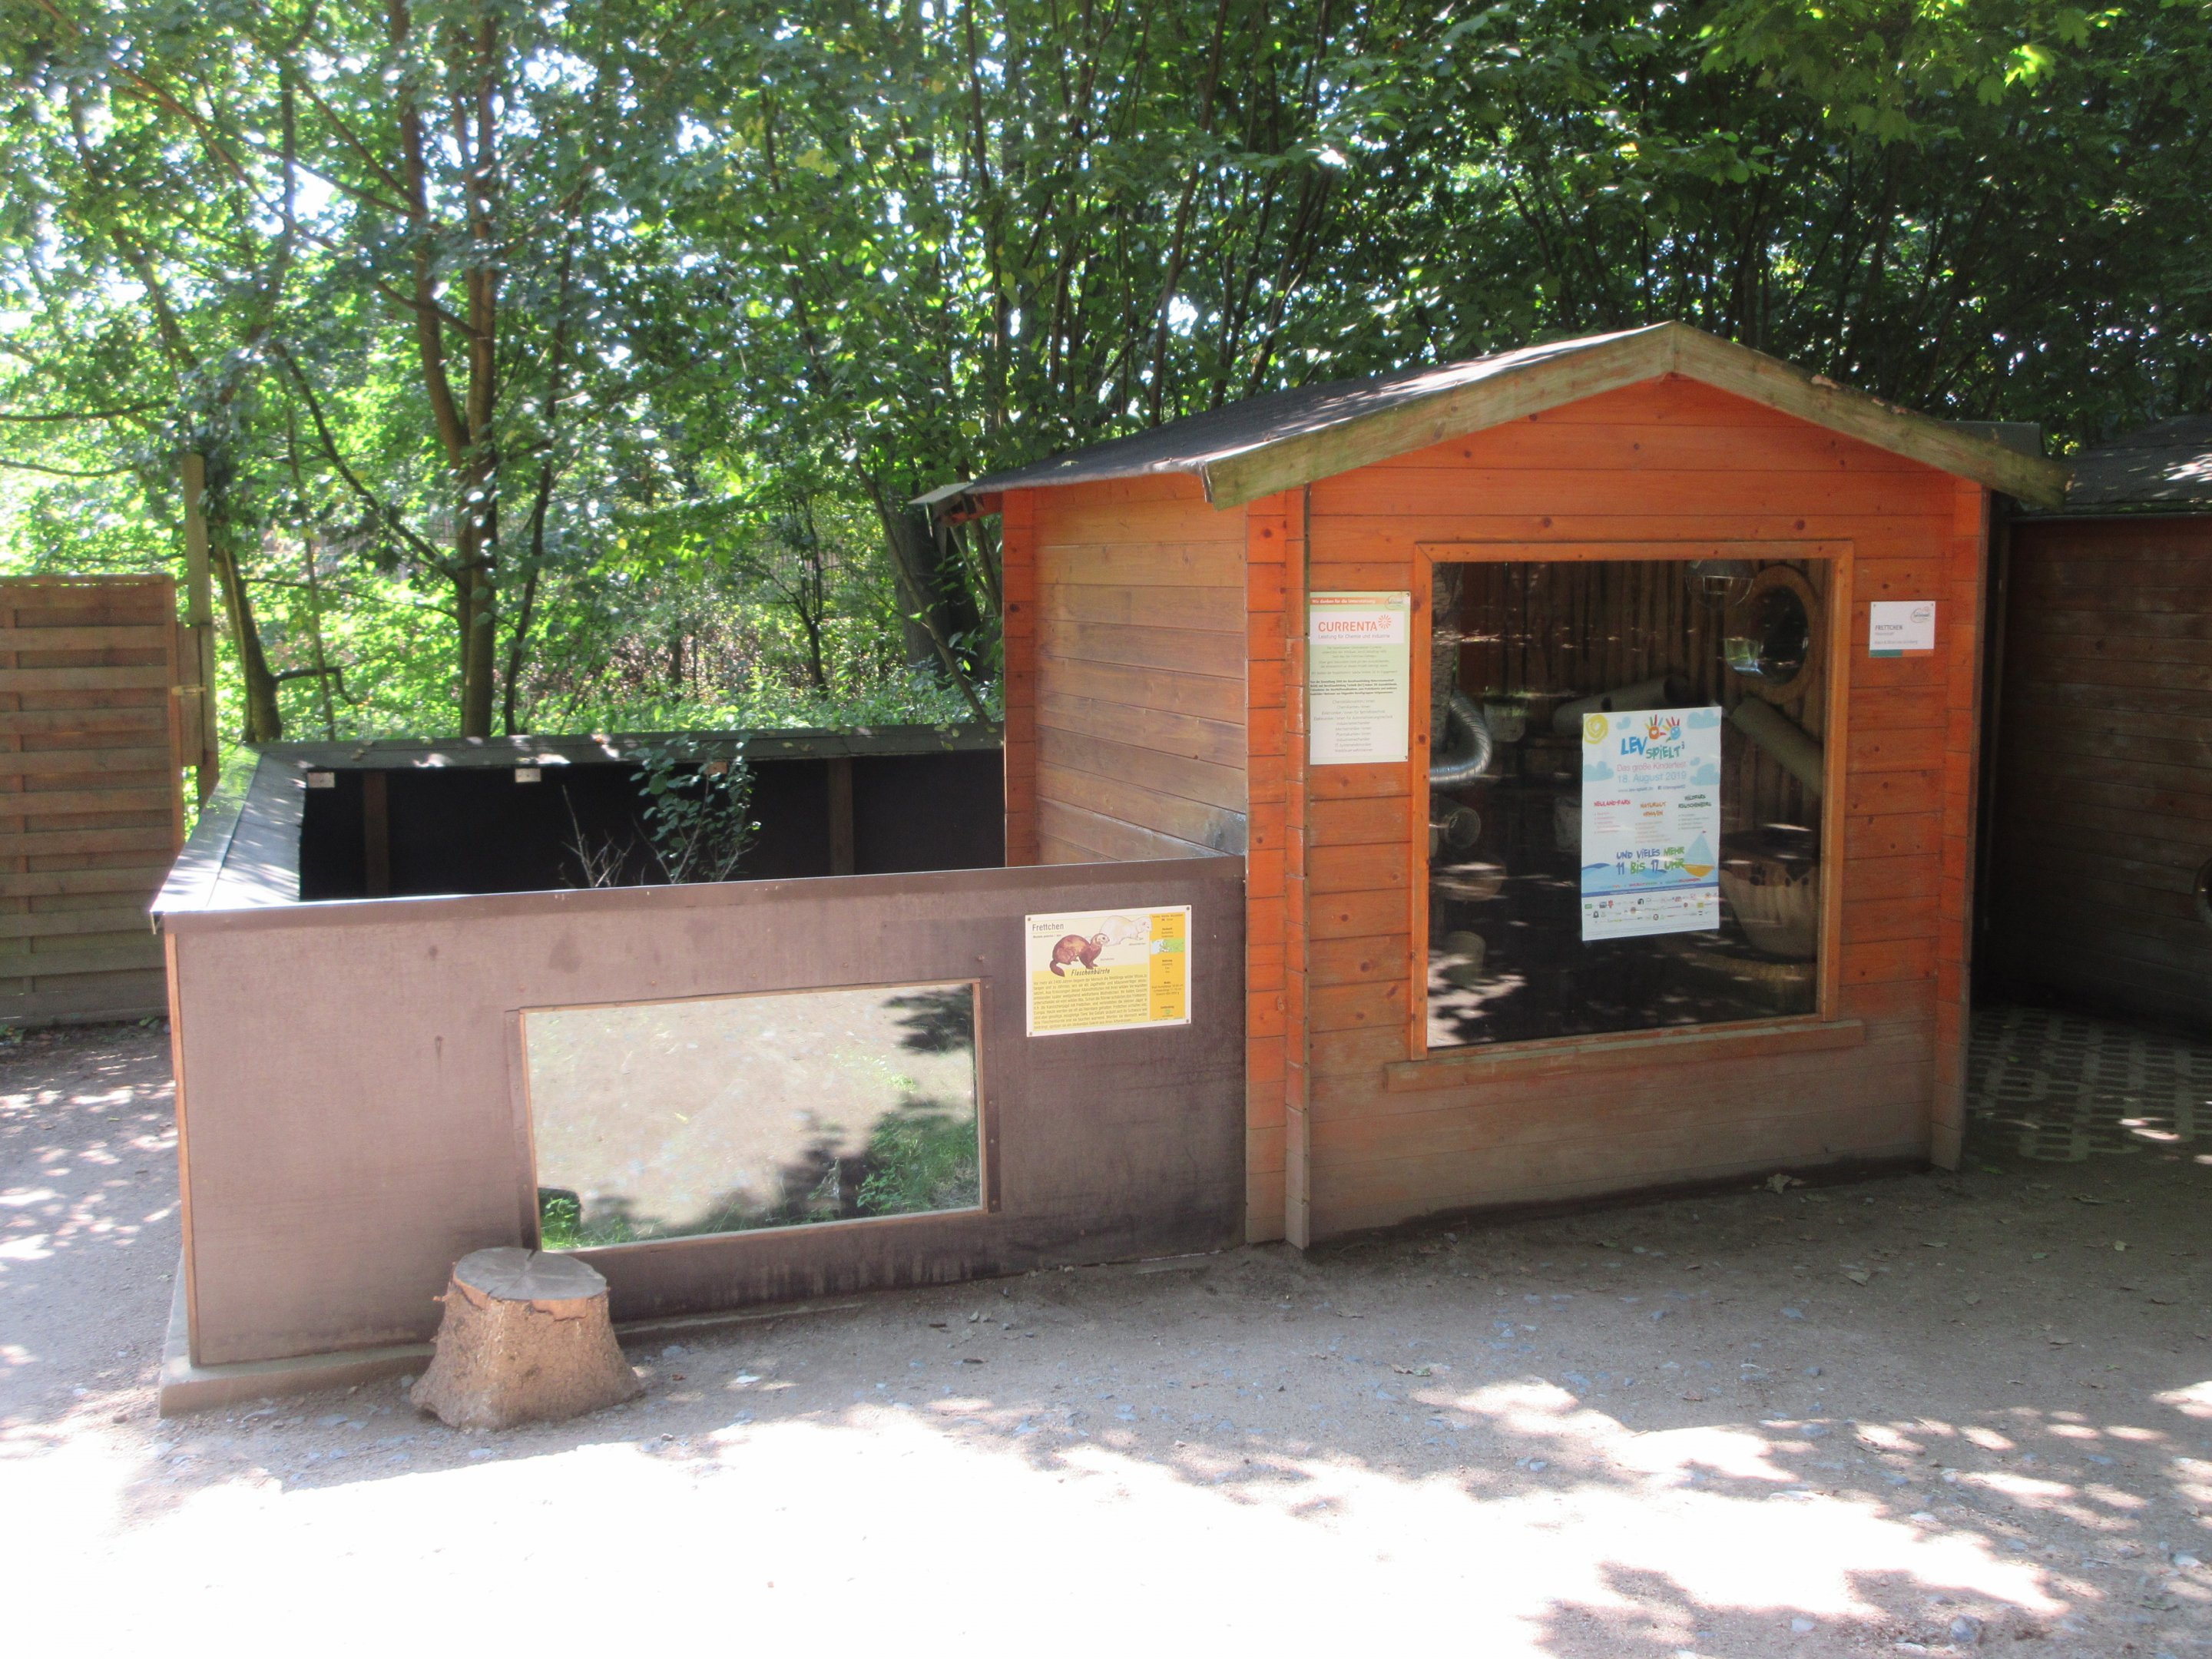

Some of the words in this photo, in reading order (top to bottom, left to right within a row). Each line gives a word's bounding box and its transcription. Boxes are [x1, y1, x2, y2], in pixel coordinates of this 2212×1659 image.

[1318, 621, 1378, 632] CURRENTA
[1621, 736, 1648, 756] LEV
[1617, 763, 1631, 772] Das
[1631, 762, 1652, 773] große
[1653, 760, 1686, 770] Kinderfest
[1618, 774, 1630, 783] 18.
[1633, 773, 1664, 783] August
[1665, 770, 1687, 781] 2019
[1616, 849, 1633, 859] UND
[1663, 846, 1685, 856] MEHR
[1616, 861, 1625, 876] 11
[1664, 857, 1685, 871] UHR
[1031, 922, 1065, 931] Frettchen
[1071, 967, 1111, 977] Flaschenbürste
